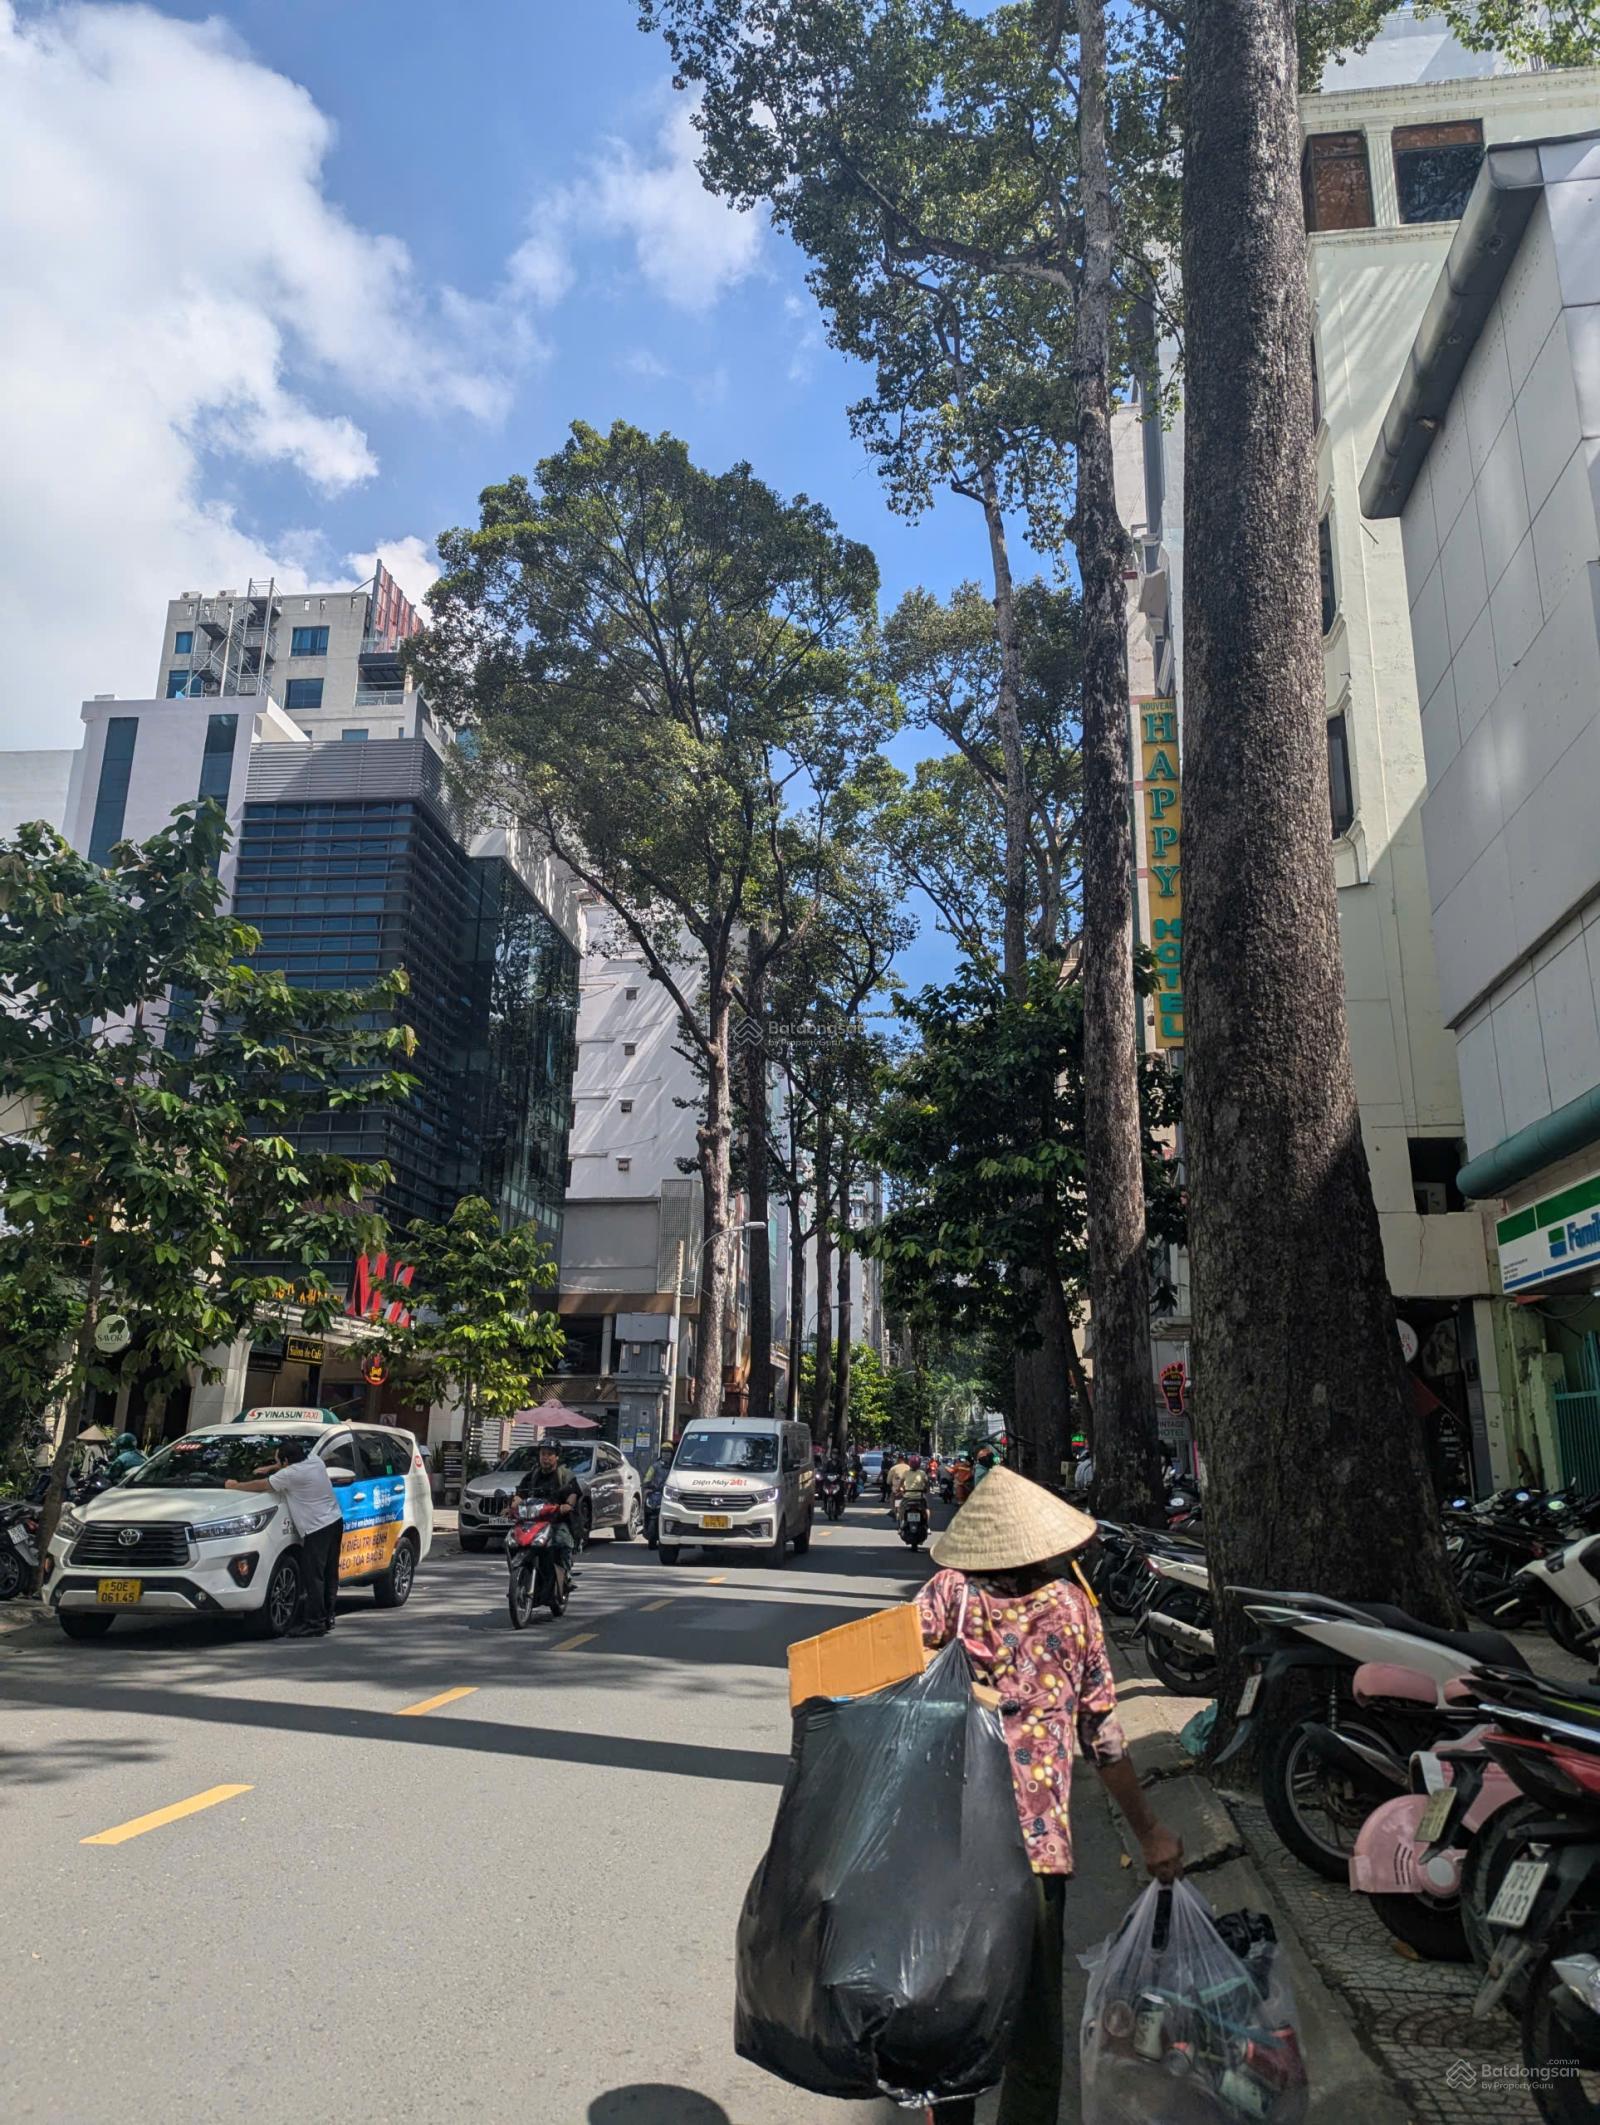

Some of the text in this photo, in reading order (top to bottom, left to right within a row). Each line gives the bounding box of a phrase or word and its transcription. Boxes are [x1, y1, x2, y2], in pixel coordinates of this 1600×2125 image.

[1144, 712, 1184, 1038] HAPPY HOTEL
[264, 1410, 303, 1420] VINASUN
